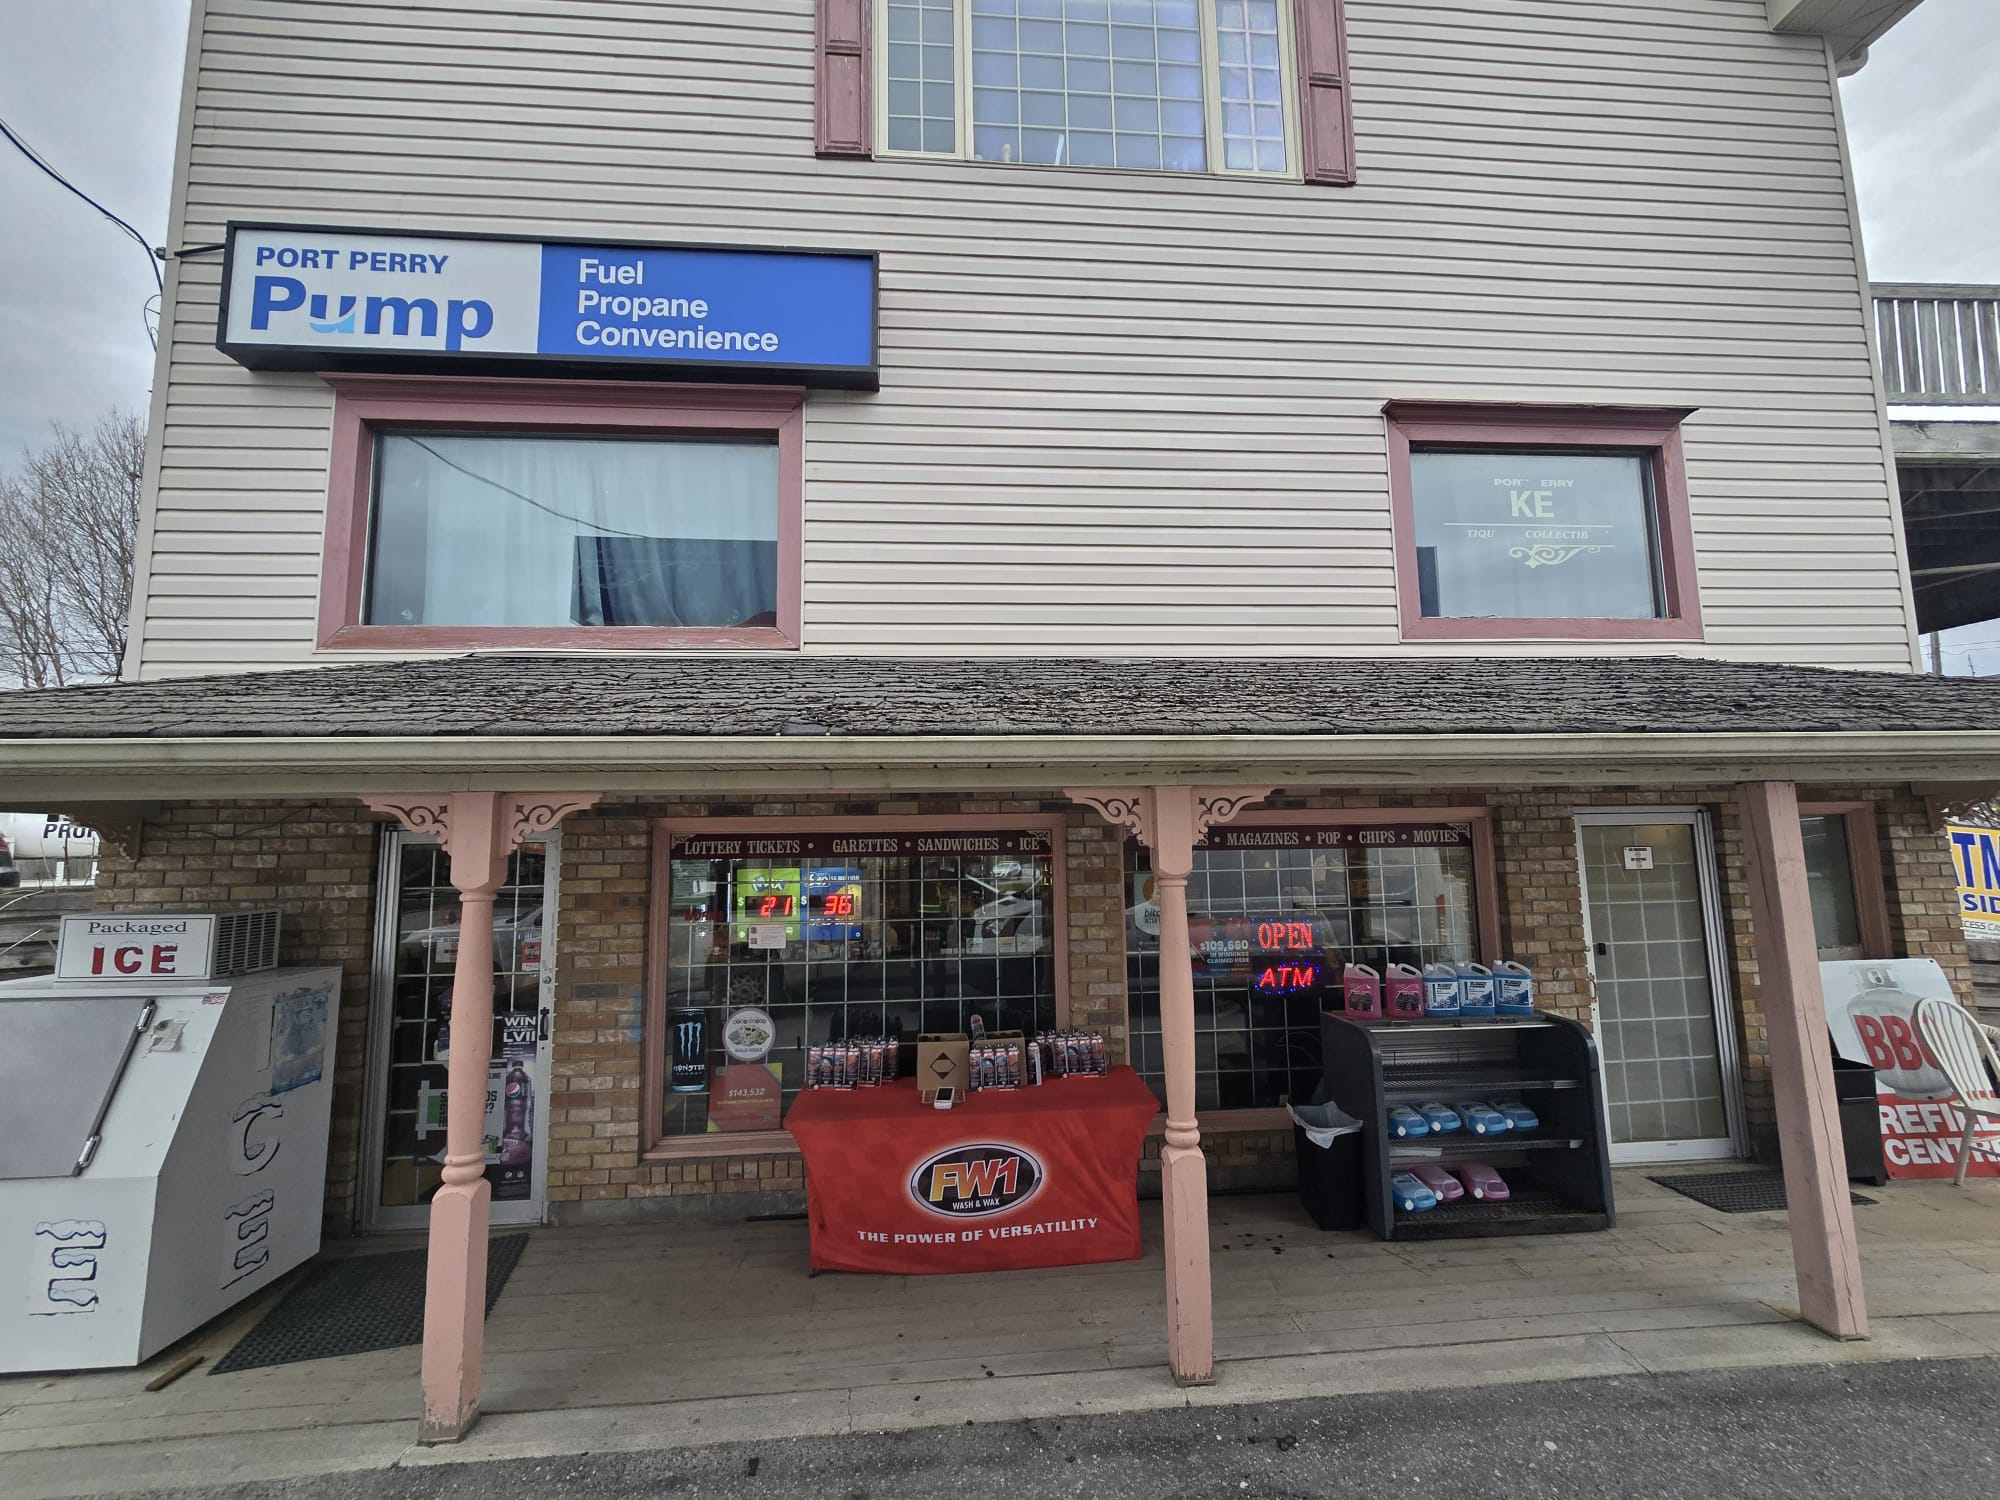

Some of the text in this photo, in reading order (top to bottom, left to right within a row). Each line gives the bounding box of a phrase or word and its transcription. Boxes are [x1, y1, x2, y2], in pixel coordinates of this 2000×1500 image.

[256, 246, 449, 275] PORT PERRY
[578, 257, 643, 285] Fuel
[250, 274, 494, 350] Pump
[578, 288, 708, 319] Propane
[575, 320, 779, 352] Convenience
[1540, 479, 1574, 488] ERRY
[684, 840, 742, 855] LOTTERY
[747, 839, 800, 854] TICKETS
[917, 837, 999, 851] SANDWICHES
[1019, 837, 1040, 851] ICE
[1226, 829, 1459, 846] MAGAZINES POP CHIPS MOVIES
[1951, 832, 2000, 890] TM
[760, 896, 792, 917] 21
[801, 896, 807, 905] $
[824, 895, 852, 916] 36
[89, 921, 187, 936] Packaged
[1258, 922, 1313, 949] OPEN
[1200, 940, 1248, 951] $109,660
[92, 941, 178, 975] ICE
[1260, 966, 1313, 988] ATM
[504, 1015, 537, 1027] WIN
[503, 1030, 536, 1043] LVII
[929, 1156, 1020, 1202] FW1
[952, 1198, 1000, 1211] WASH & WAX
[857, 1217, 1099, 1244] THE POWER OF VERSATILITY
